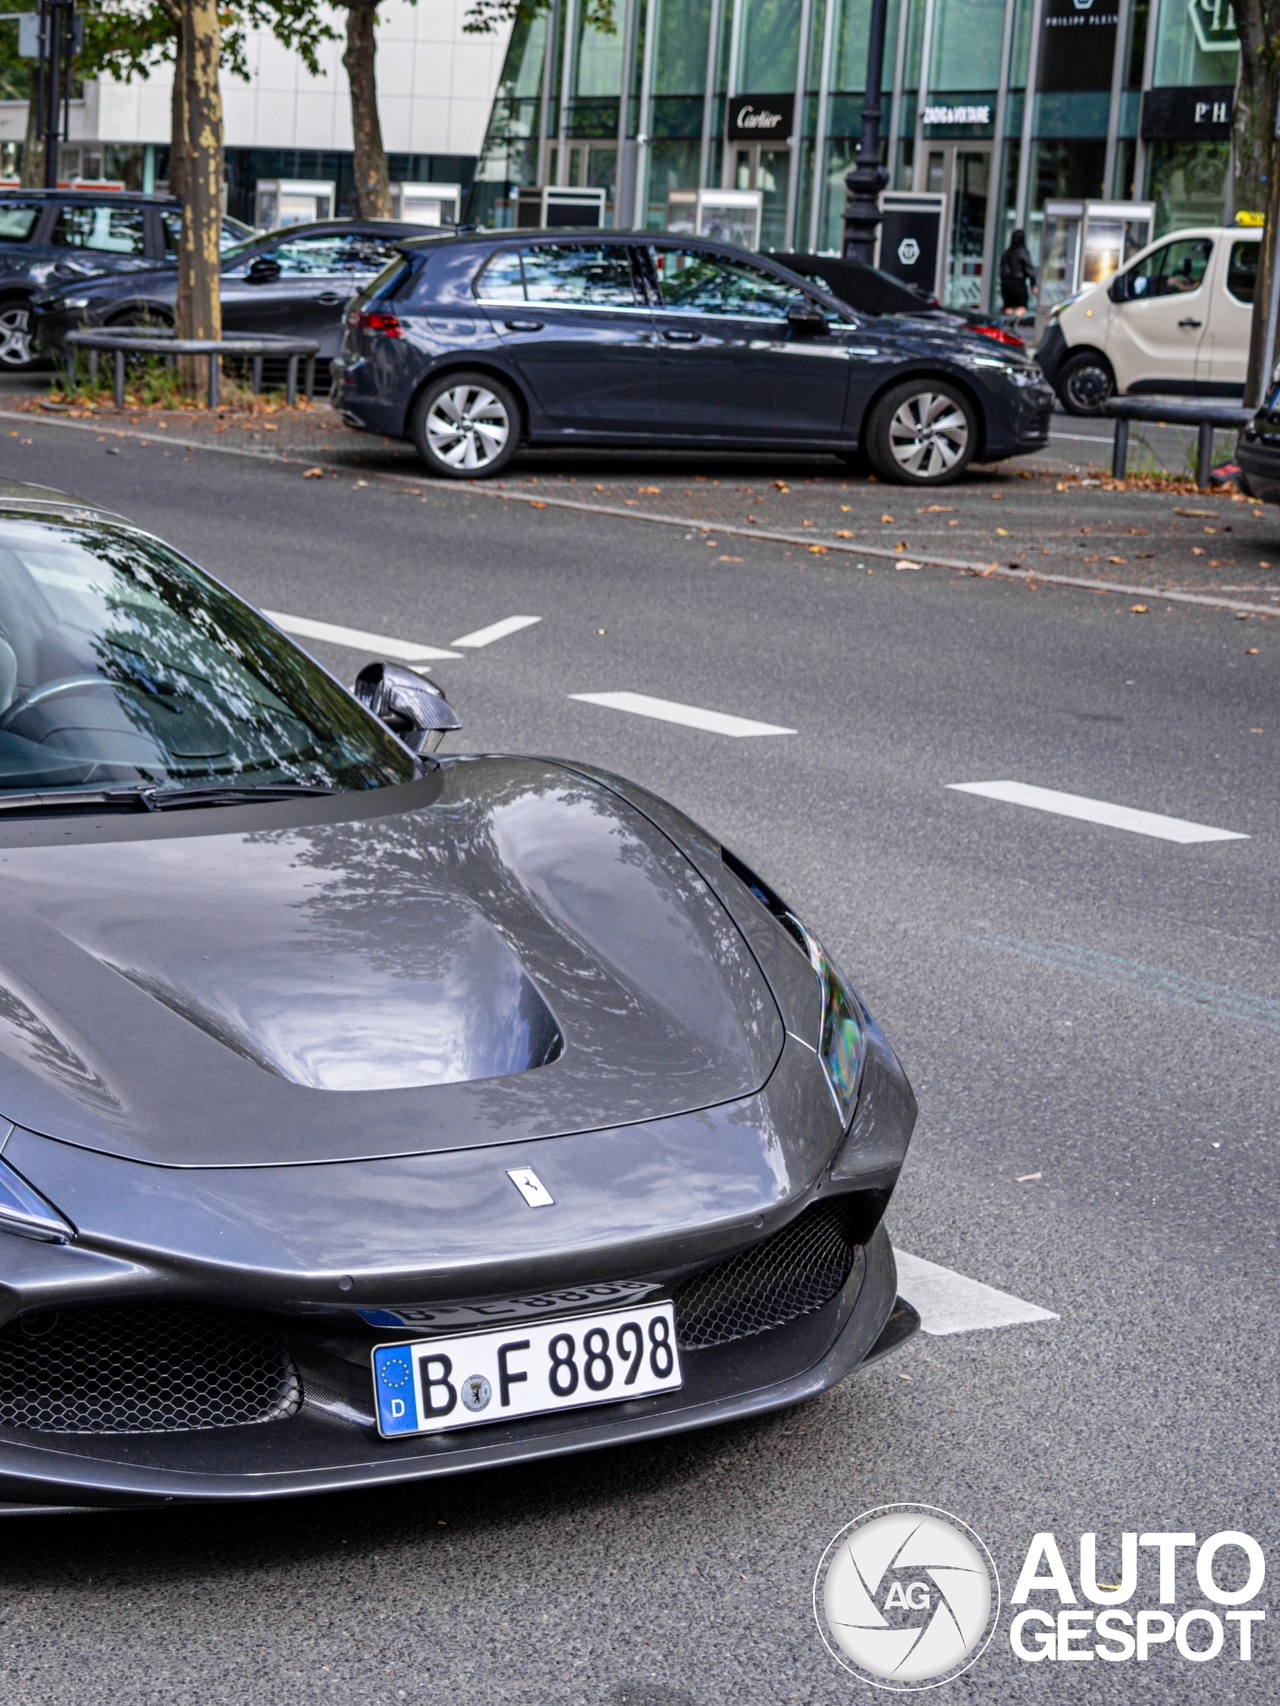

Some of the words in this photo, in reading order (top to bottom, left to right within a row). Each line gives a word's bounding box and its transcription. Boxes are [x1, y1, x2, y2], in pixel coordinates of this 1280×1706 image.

[1045, 16, 1085, 27] PHILIPP
[737, 105, 782, 129] Cartier
[418, 1353, 458, 1419] B
[497, 1339, 530, 1407] F
[548, 1316, 674, 1397] 8898
[391, 1398, 406, 1418] D
